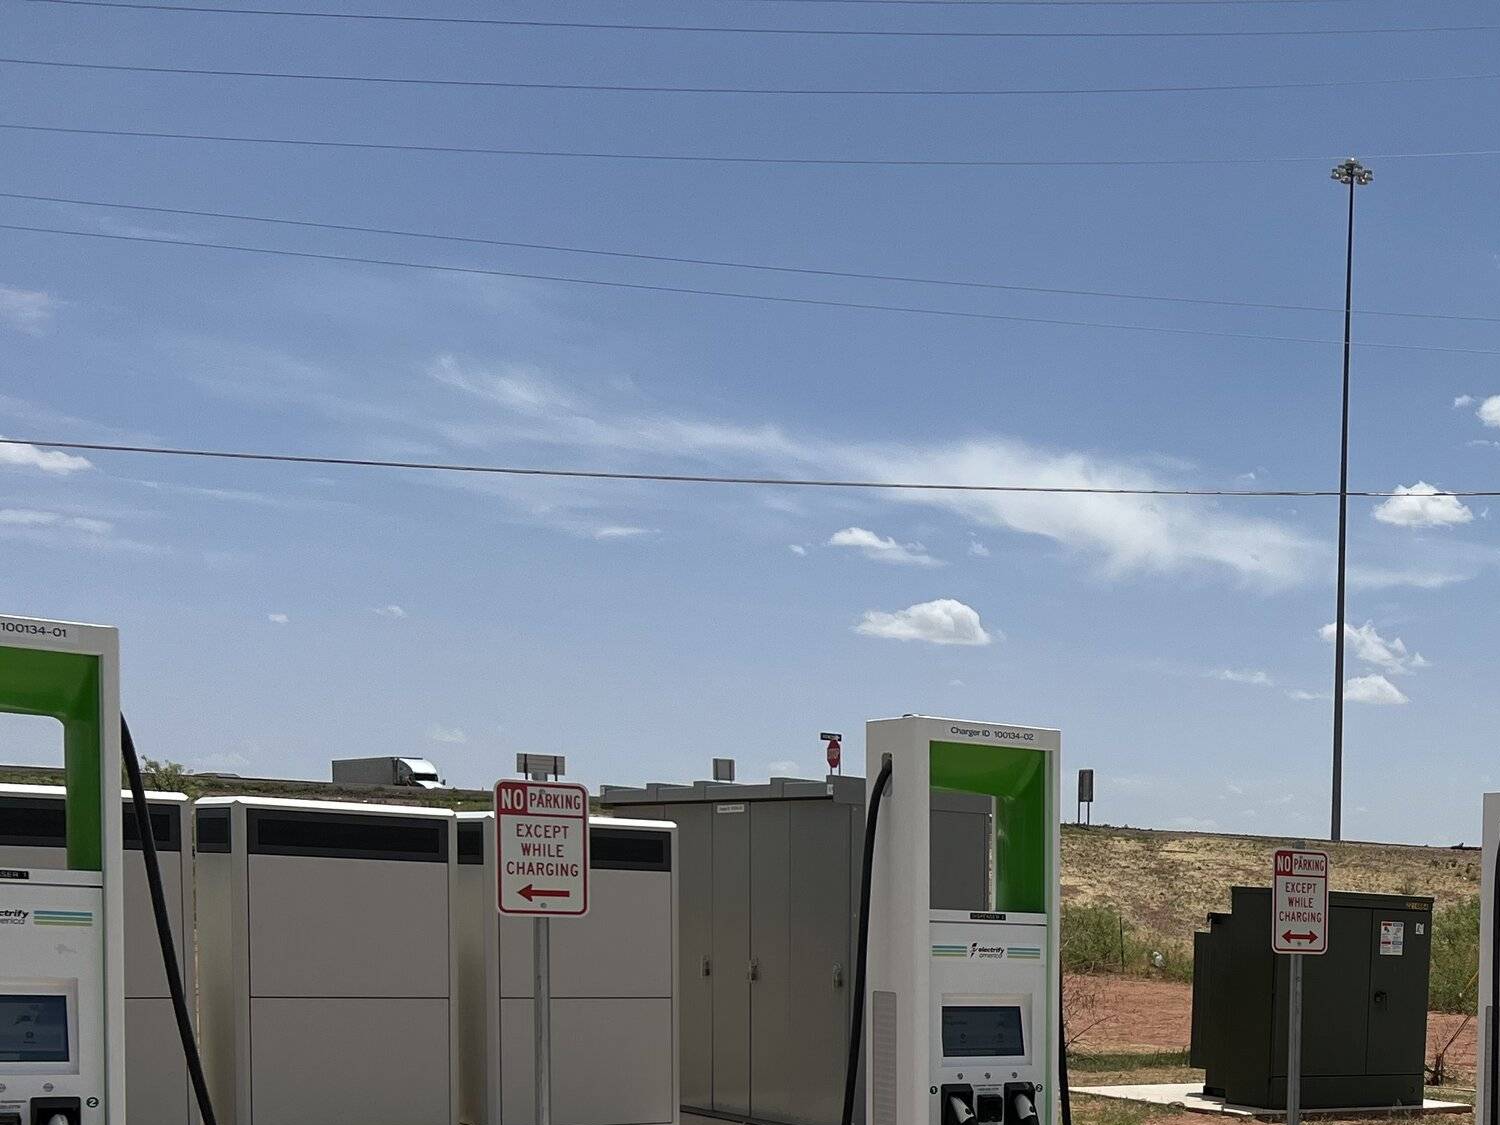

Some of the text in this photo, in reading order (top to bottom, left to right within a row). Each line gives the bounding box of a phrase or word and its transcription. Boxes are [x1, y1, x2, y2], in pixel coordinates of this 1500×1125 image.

[1, 622, 67, 637] 100134-01
[951, 726, 981, 737] Charger
[994, 731, 1034, 741] 100134-02
[501, 788, 580, 810] NO PARKING
[516, 823, 570, 839] EXCEPT
[521, 843, 564, 858] WHILE
[506, 861, 578, 877] CHARGING
[1277, 855, 1325, 872] NO PARKING
[1285, 882, 1317, 894] EXCEPT
[1288, 896, 1313, 909] WHILE
[1279, 911, 1322, 923] CHARGING
